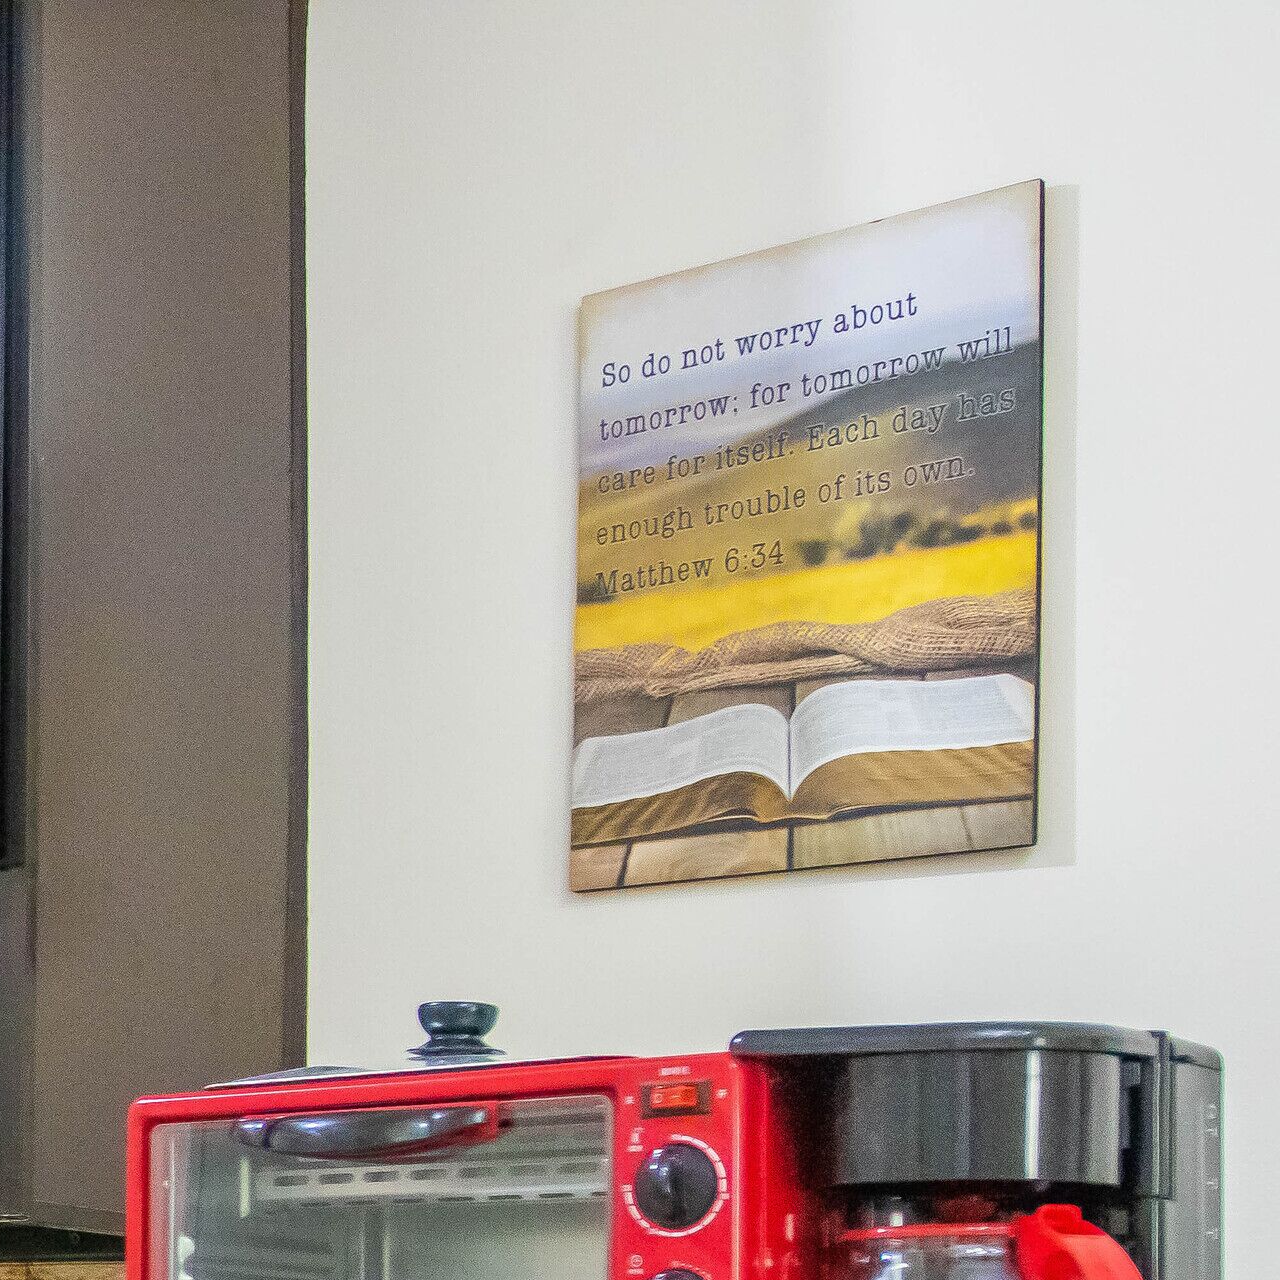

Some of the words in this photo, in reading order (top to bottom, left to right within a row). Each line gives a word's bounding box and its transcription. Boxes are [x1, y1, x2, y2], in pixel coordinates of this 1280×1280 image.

[599, 395, 738, 441] tomorrow;
[750, 382, 790, 409] for
[801, 342, 946, 395] tomorrow
[957, 327, 1011, 362] will
[602, 362, 630, 388] So
[642, 353, 670, 380] do
[682, 337, 725, 369] not
[735, 319, 821, 356] worry
[833, 291, 917, 333] about
[598, 466, 655, 493] care
[667, 454, 705, 481] for
[716, 437, 793, 473] itself.
[807, 413, 879, 452] Each
[892, 401, 946, 435] day
[957, 386, 1016, 421] has
[596, 506, 692, 546] enough
[704, 487, 805, 525] trouble
[818, 474, 845, 504] of
[856, 468, 890, 497] its
[904, 454, 975, 487] own.
[596, 555, 712, 597] Matthew
[725, 540, 784, 573] 6:34
